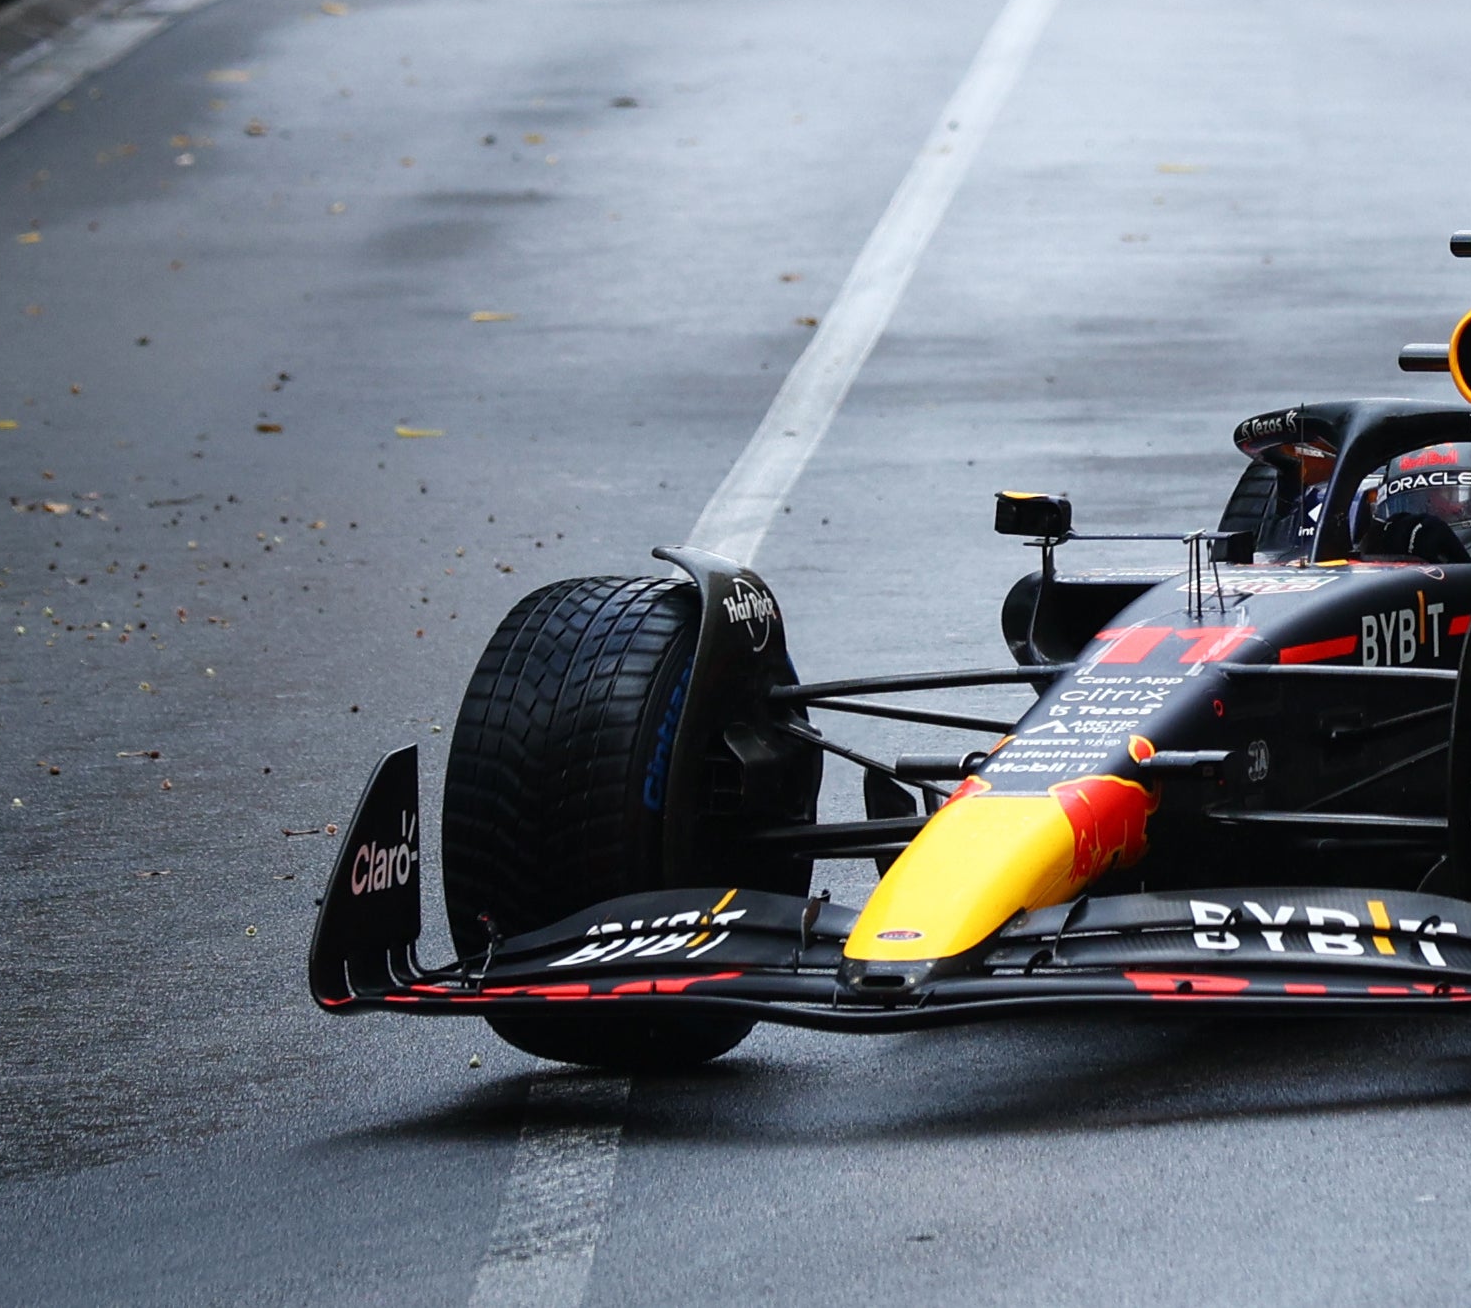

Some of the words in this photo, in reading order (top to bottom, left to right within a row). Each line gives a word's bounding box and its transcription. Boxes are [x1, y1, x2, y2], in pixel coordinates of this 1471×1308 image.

[1251, 417, 1283, 437] Tezos
[1361, 589, 1445, 667] BYBIT
[1095, 626, 1257, 664] 11
[1076, 676, 1131, 685] Cash
[1134, 676, 1184, 687] App
[1059, 687, 1172, 702] citrix
[1077, 705, 1154, 716] Tezos
[1068, 720, 1141, 728] ARCTIC
[1074, 726, 1127, 734] WOLF
[985, 762, 1069, 774] Mobil
[350, 835, 413, 897] Claro
[1189, 900, 1458, 968] BYBIT
